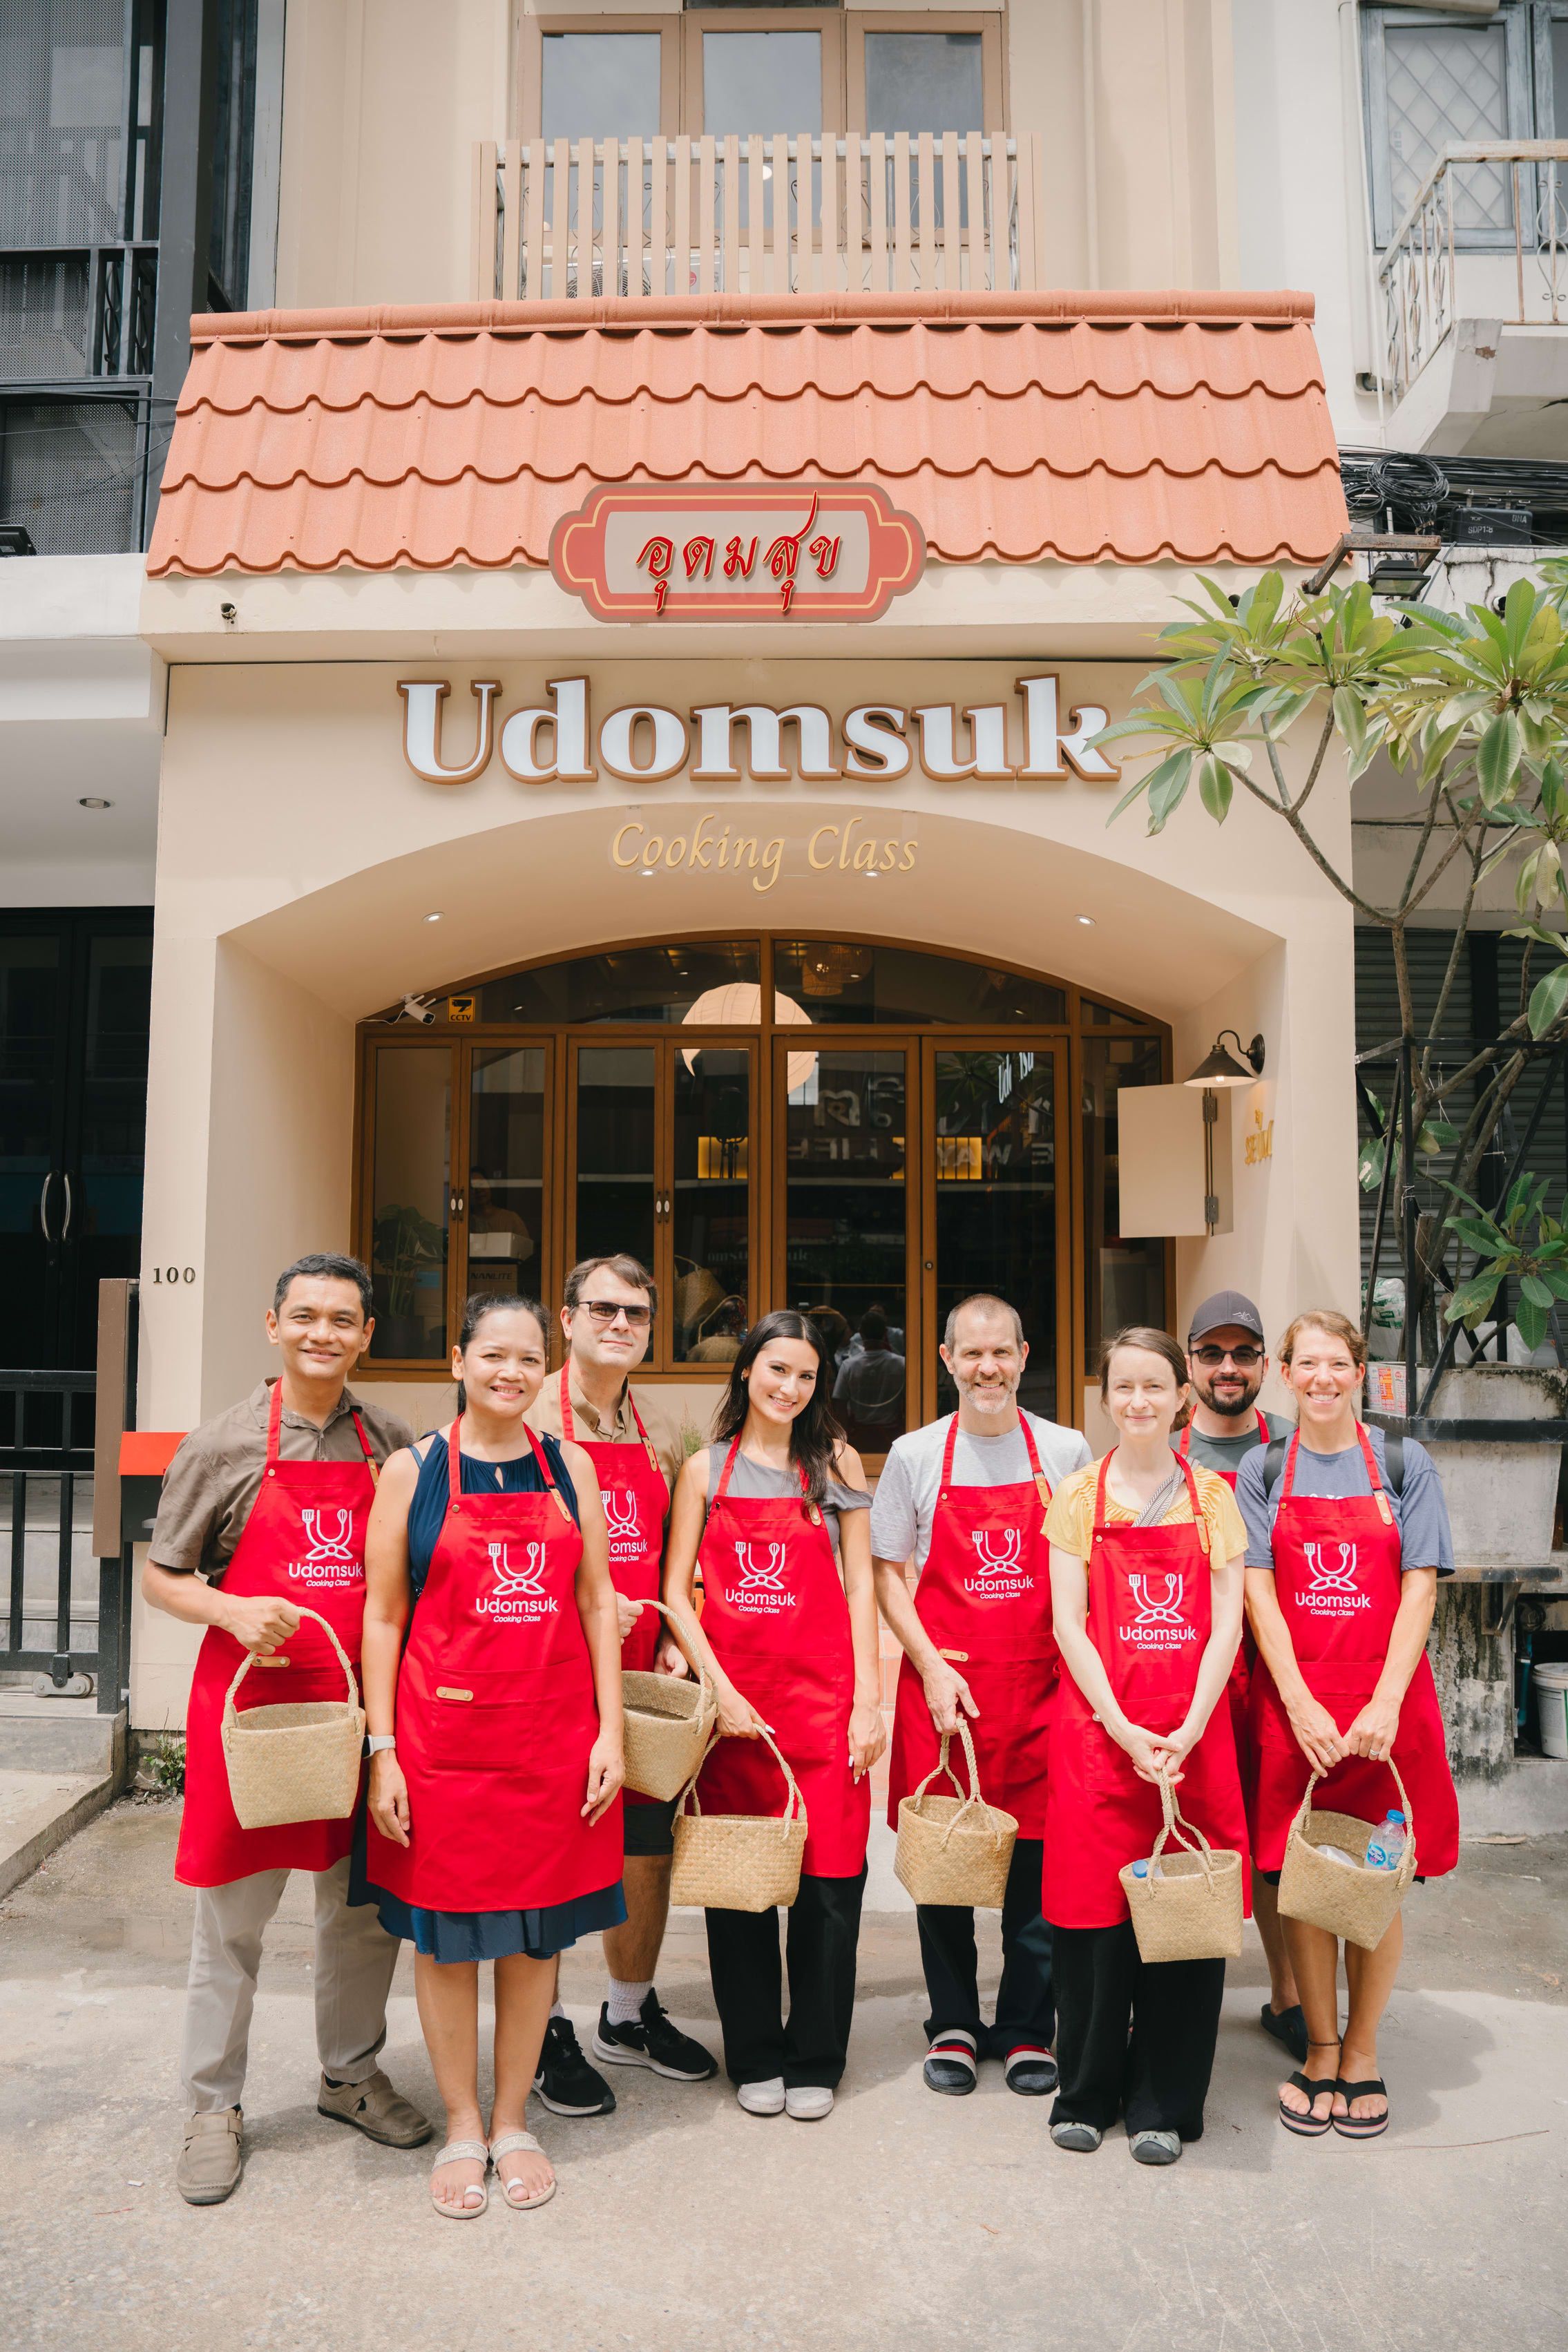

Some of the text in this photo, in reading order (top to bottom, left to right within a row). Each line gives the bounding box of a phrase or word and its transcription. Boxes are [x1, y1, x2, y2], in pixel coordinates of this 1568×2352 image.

[636, 490, 841, 612] อุดมสุข
[396, 673, 1122, 785] Udomsuk
[612, 814, 918, 891] Cooking Class
[153, 1267, 195, 1283] 100
[609, 1538, 648, 1553] omsuk
[289, 1562, 363, 1578] Udomsuk
[306, 1579, 334, 1587] Cooking
[964, 1575, 1035, 1591] Udomsuk
[476, 1596, 559, 1614] Udomsuk
[725, 1588, 796, 1606] Udomsuk
[1295, 1592, 1372, 1609] Udomsuk
[738, 1605, 763, 1614] Cooking
[1310, 1608, 1337, 1616] Cooking
[493, 1615, 522, 1623] Cooking
[1119, 1625, 1197, 1641] Udomsuk
